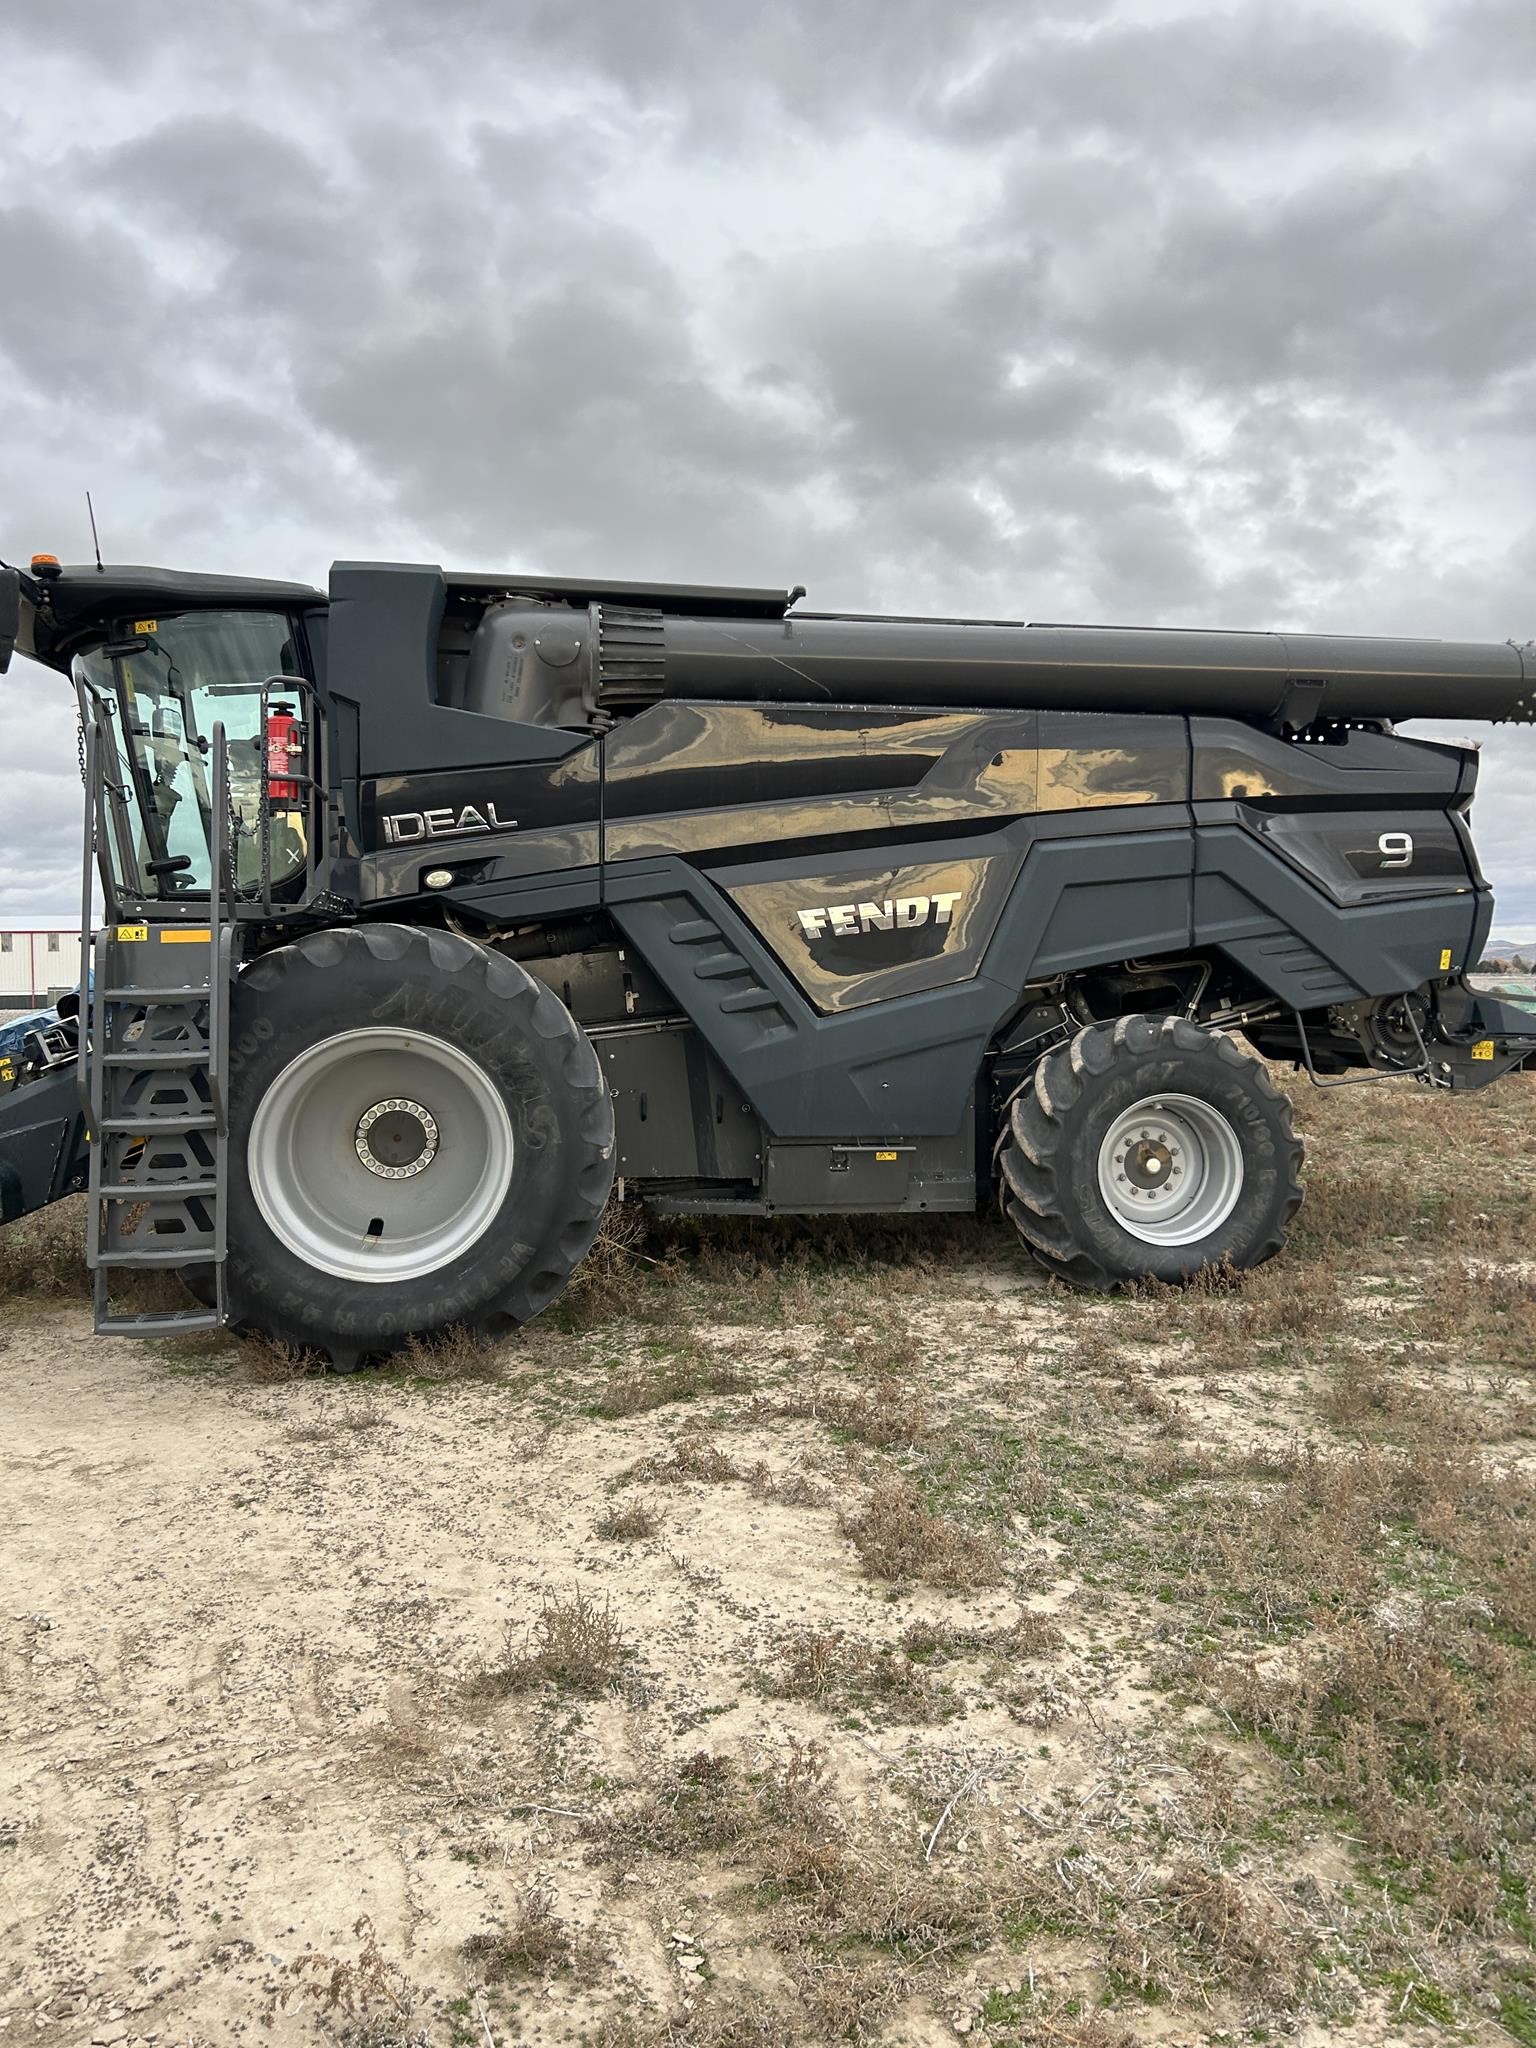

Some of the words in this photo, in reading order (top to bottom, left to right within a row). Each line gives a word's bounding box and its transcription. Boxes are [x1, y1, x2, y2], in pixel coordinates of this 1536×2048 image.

[382, 802, 518, 843] IDEAL
[1378, 832, 1413, 868] 9
[797, 892, 962, 939] FENDT
